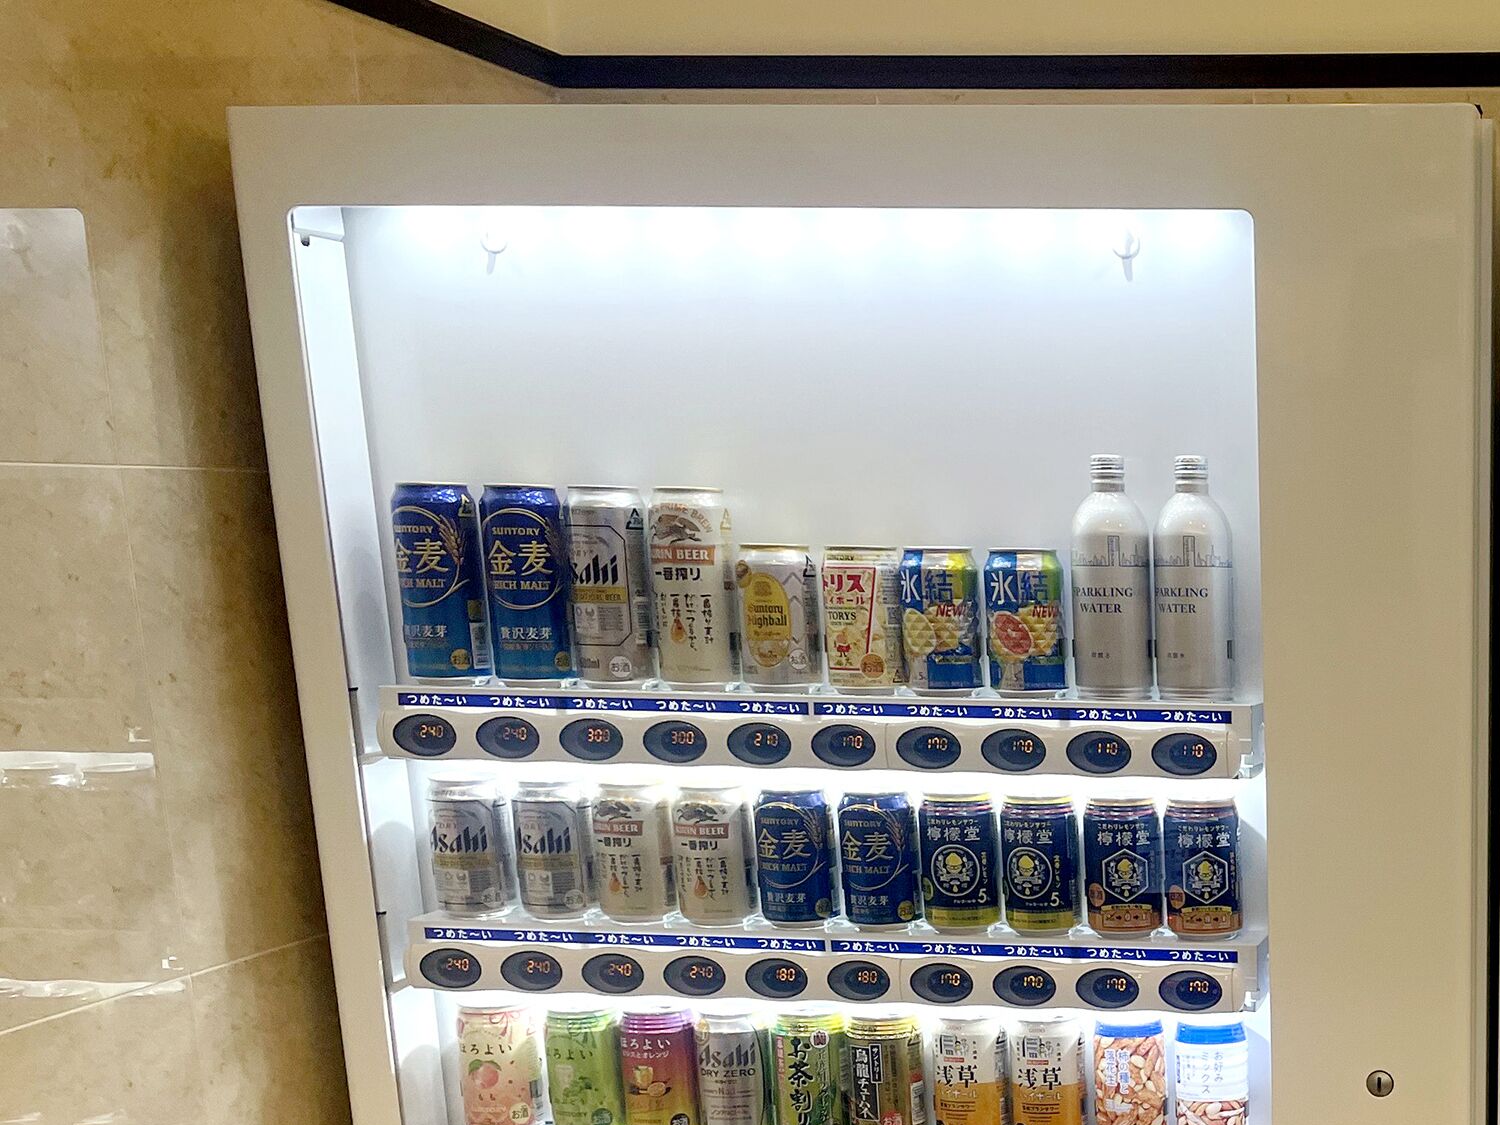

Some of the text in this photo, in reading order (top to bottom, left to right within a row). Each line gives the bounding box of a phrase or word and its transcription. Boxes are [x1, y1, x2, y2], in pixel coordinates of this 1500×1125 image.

[492, 527, 540, 536] SUNTORY
[488, 540, 553, 576] 金麦
[677, 548, 710, 561] BEER
[655, 567, 701, 581] 一番搾り
[901, 570, 953, 602] 氷結
[991, 571, 1048, 605] 氷結
[1080, 603, 1122, 614] WATER
[1158, 603, 1196, 614] WATER
[828, 612, 856, 621] TORYS
[420, 724, 444, 738] 240
[587, 728, 611, 743] 300
[671, 730, 694, 745] 300
[1097, 741, 1118, 756] 110
[758, 829, 811, 861] 金麦
[842, 831, 894, 862] 金麦
[609, 963, 632, 977] 240
[776, 968, 795, 981] 180
[857, 969, 877, 984] 180
[699, 1043, 756, 1067] Asahi
[723, 1068, 756, 1078] ZERO
[937, 1065, 977, 1089] 浅草
[1018, 1066, 1061, 1090] 浅草
